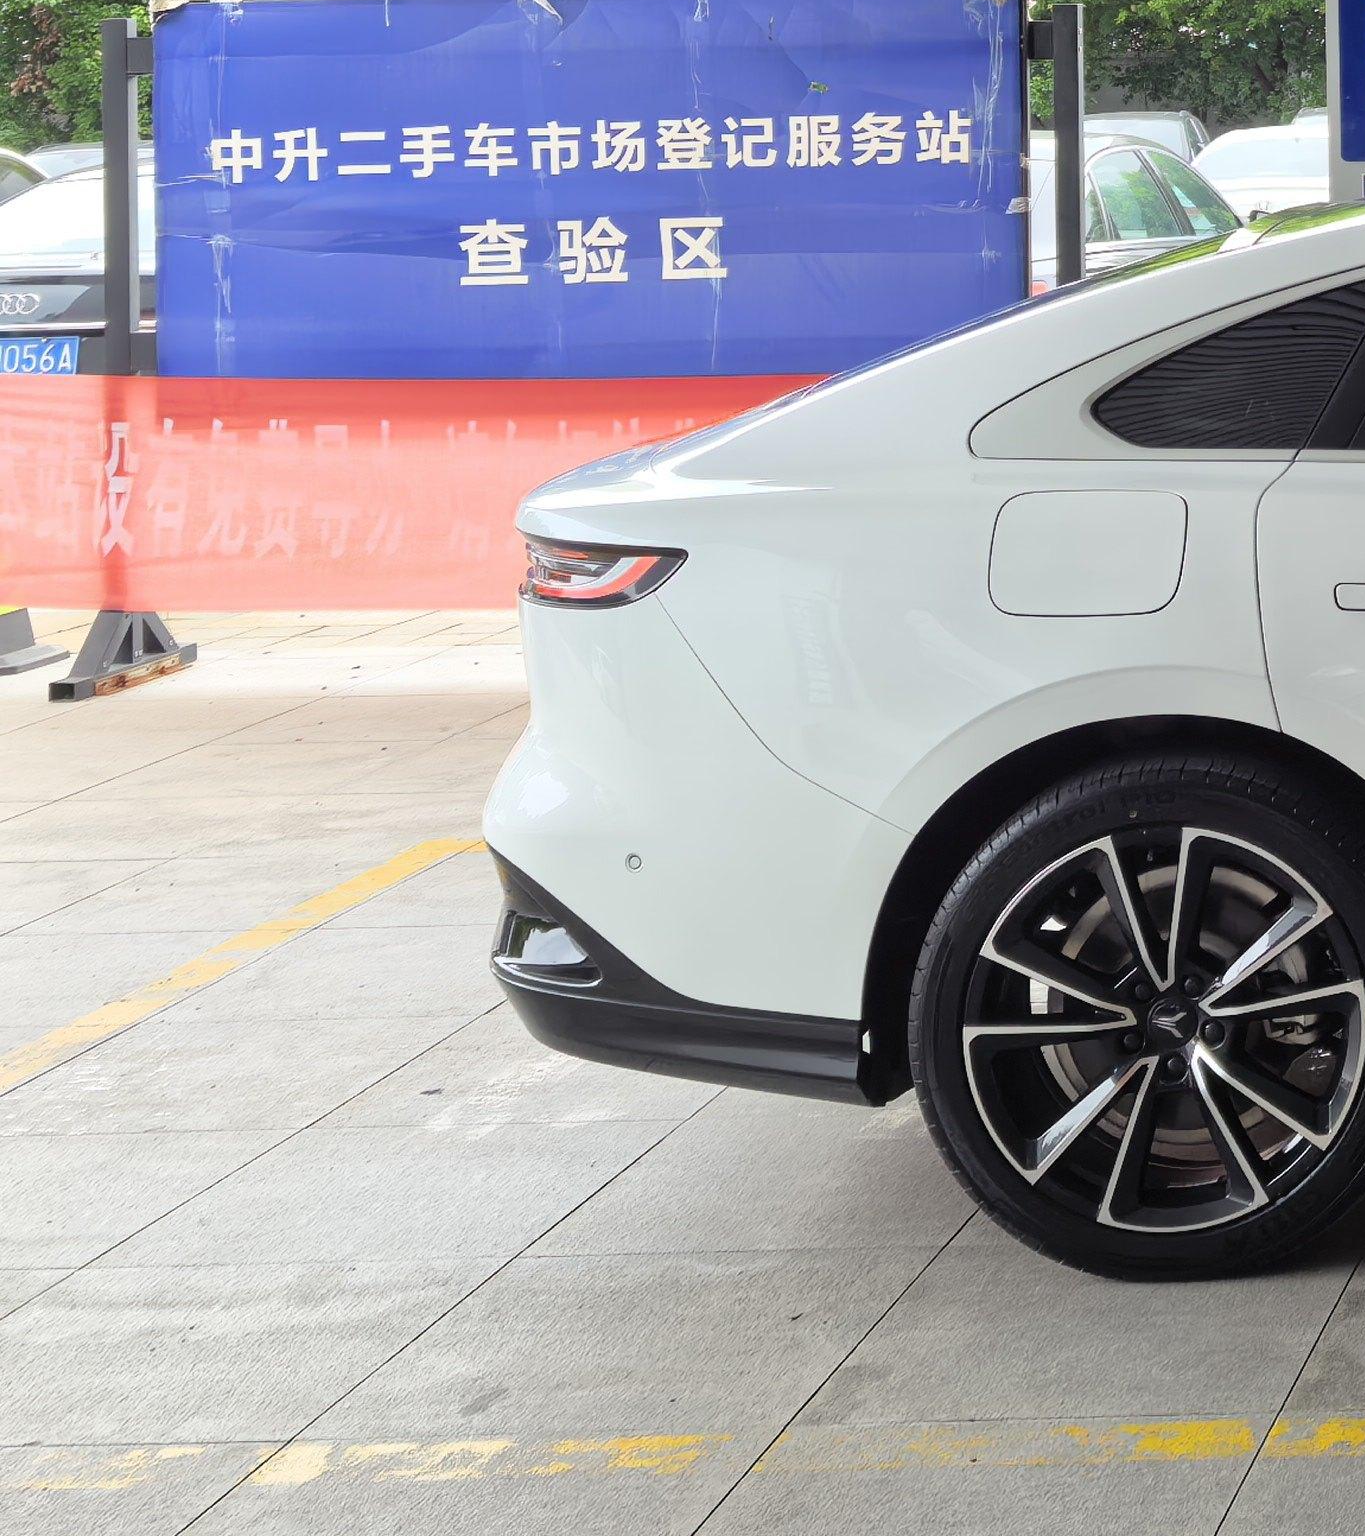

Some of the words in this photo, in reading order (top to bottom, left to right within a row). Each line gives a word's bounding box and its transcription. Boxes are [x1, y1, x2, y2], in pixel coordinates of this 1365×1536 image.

[211, 109, 972, 184] 中升二手车市场登记服务站
[458, 215, 729, 287] 查验区
[0, 343, 72, 373] 056A
